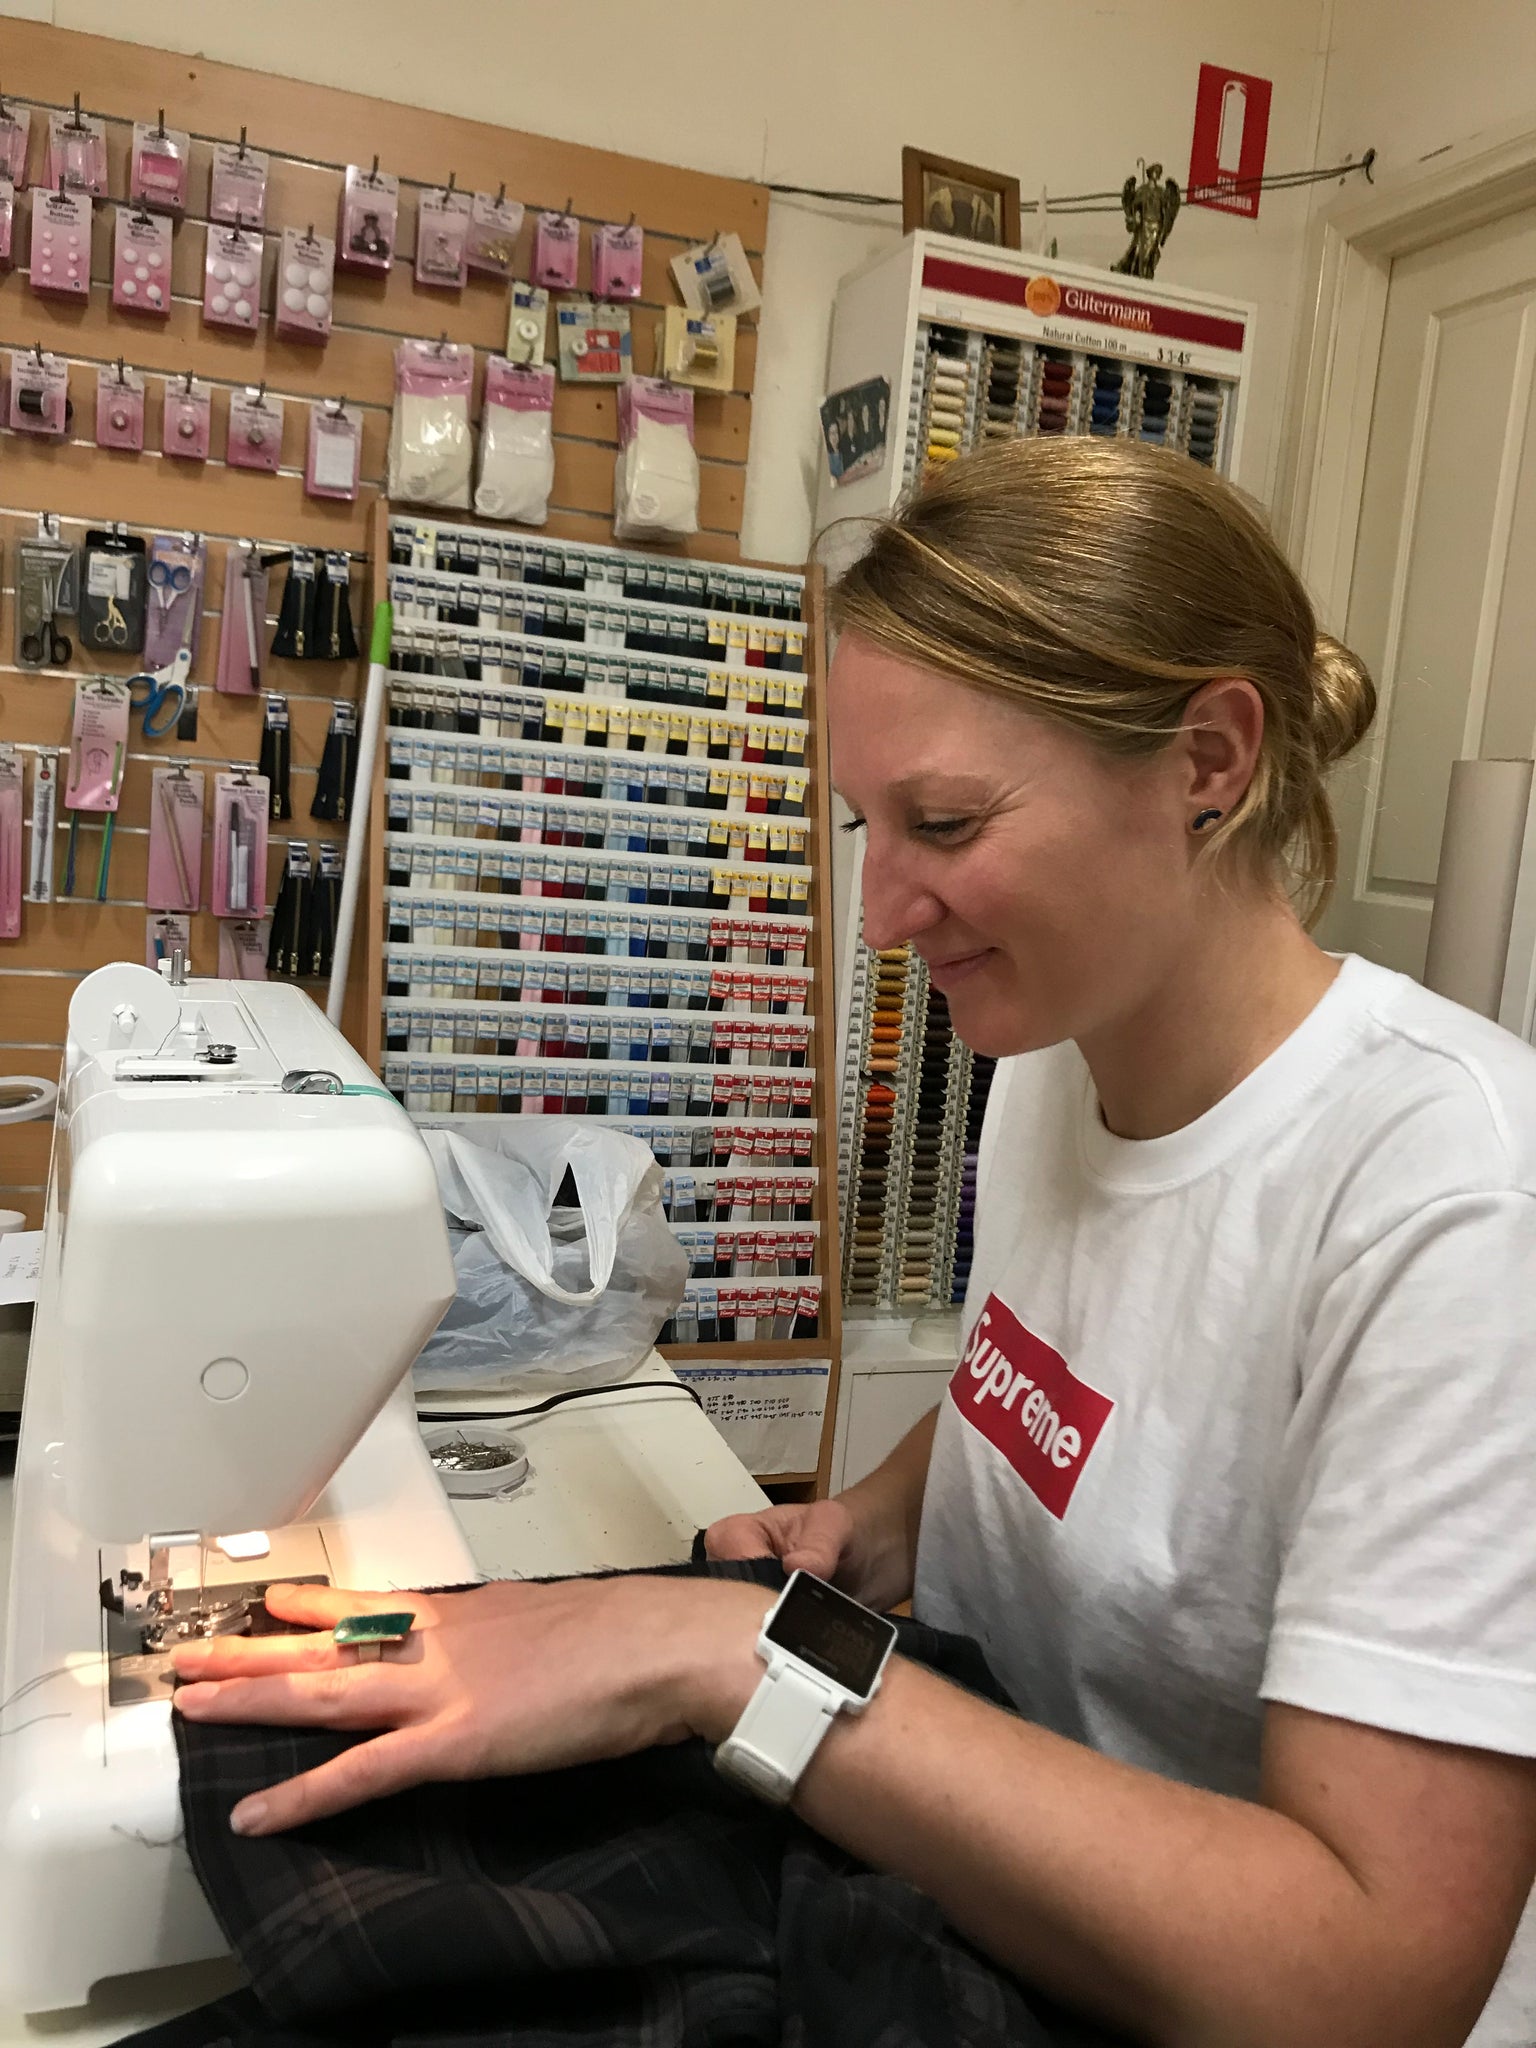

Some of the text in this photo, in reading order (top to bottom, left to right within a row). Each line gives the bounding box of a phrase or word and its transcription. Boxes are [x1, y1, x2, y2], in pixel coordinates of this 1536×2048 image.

[1042, 325, 1073, 342] Natural
[1075, 333, 1102, 347] Cotton
[1104, 338, 1118, 350] 100
[964, 1311, 1082, 1469] Supreme
